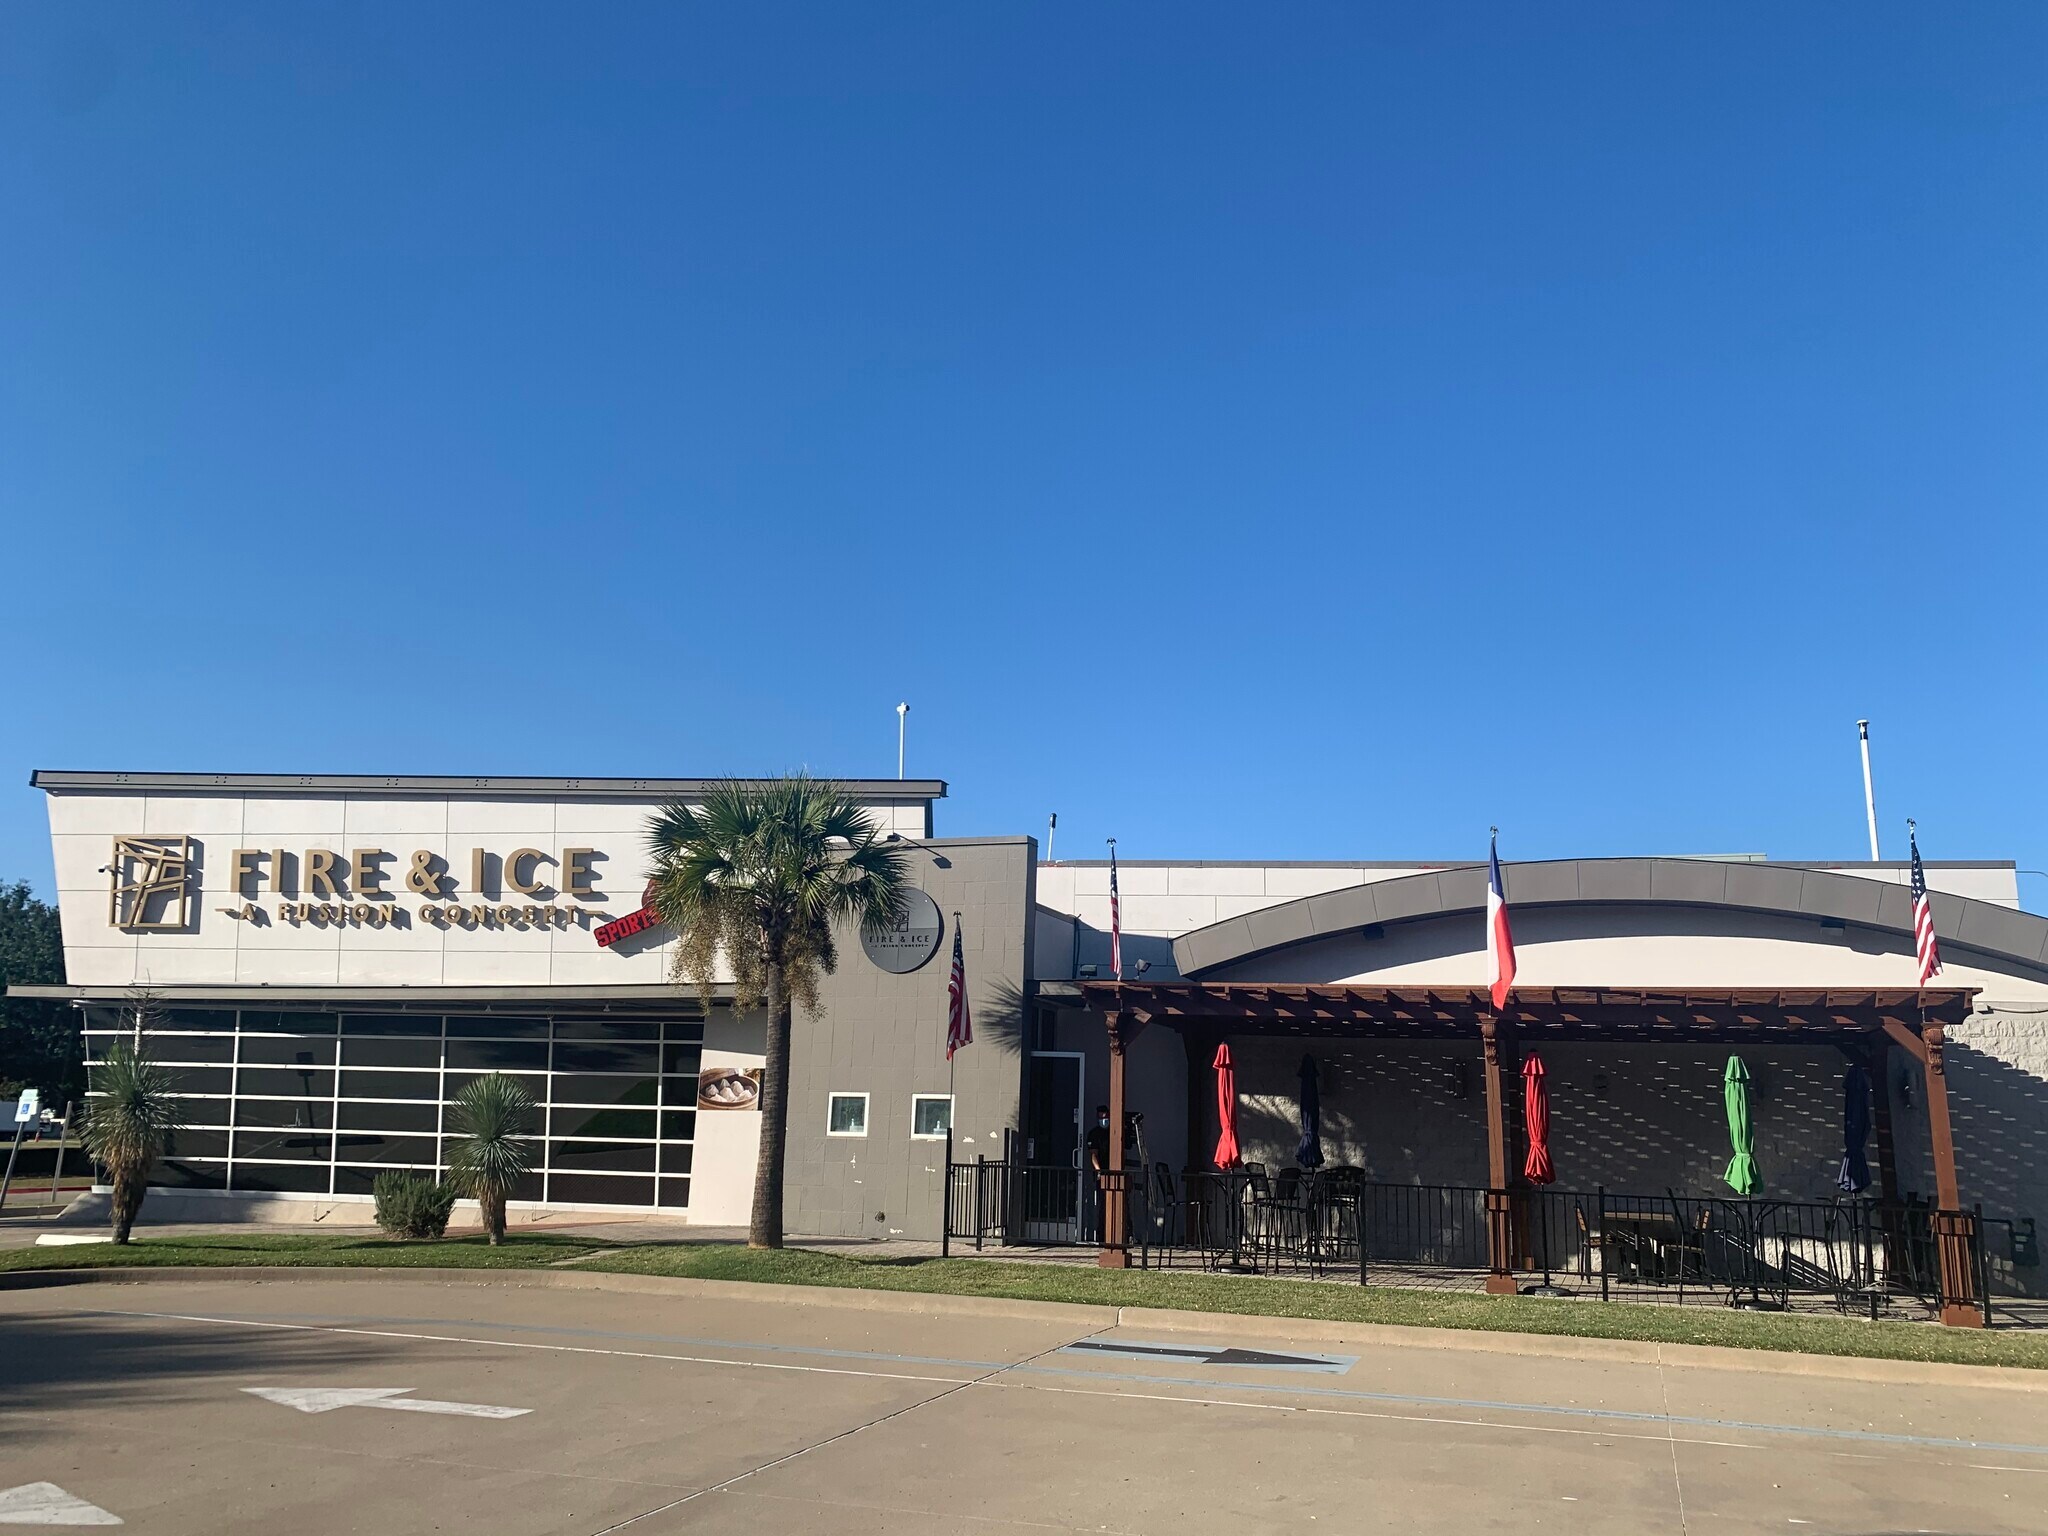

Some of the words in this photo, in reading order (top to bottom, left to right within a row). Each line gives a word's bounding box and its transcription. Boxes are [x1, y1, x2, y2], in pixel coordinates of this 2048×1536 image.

[230, 848, 382, 894] FIRE
[405, 849, 442, 895] &
[471, 847, 595, 894] ICE
[239, 902, 255, 921] A
[278, 902, 396, 923] FUSION
[418, 903, 577, 925] CONCEPT
[869, 935, 894, 943] FIRE
[900, 935, 906, 943] &
[911, 935, 930, 943] ICE
